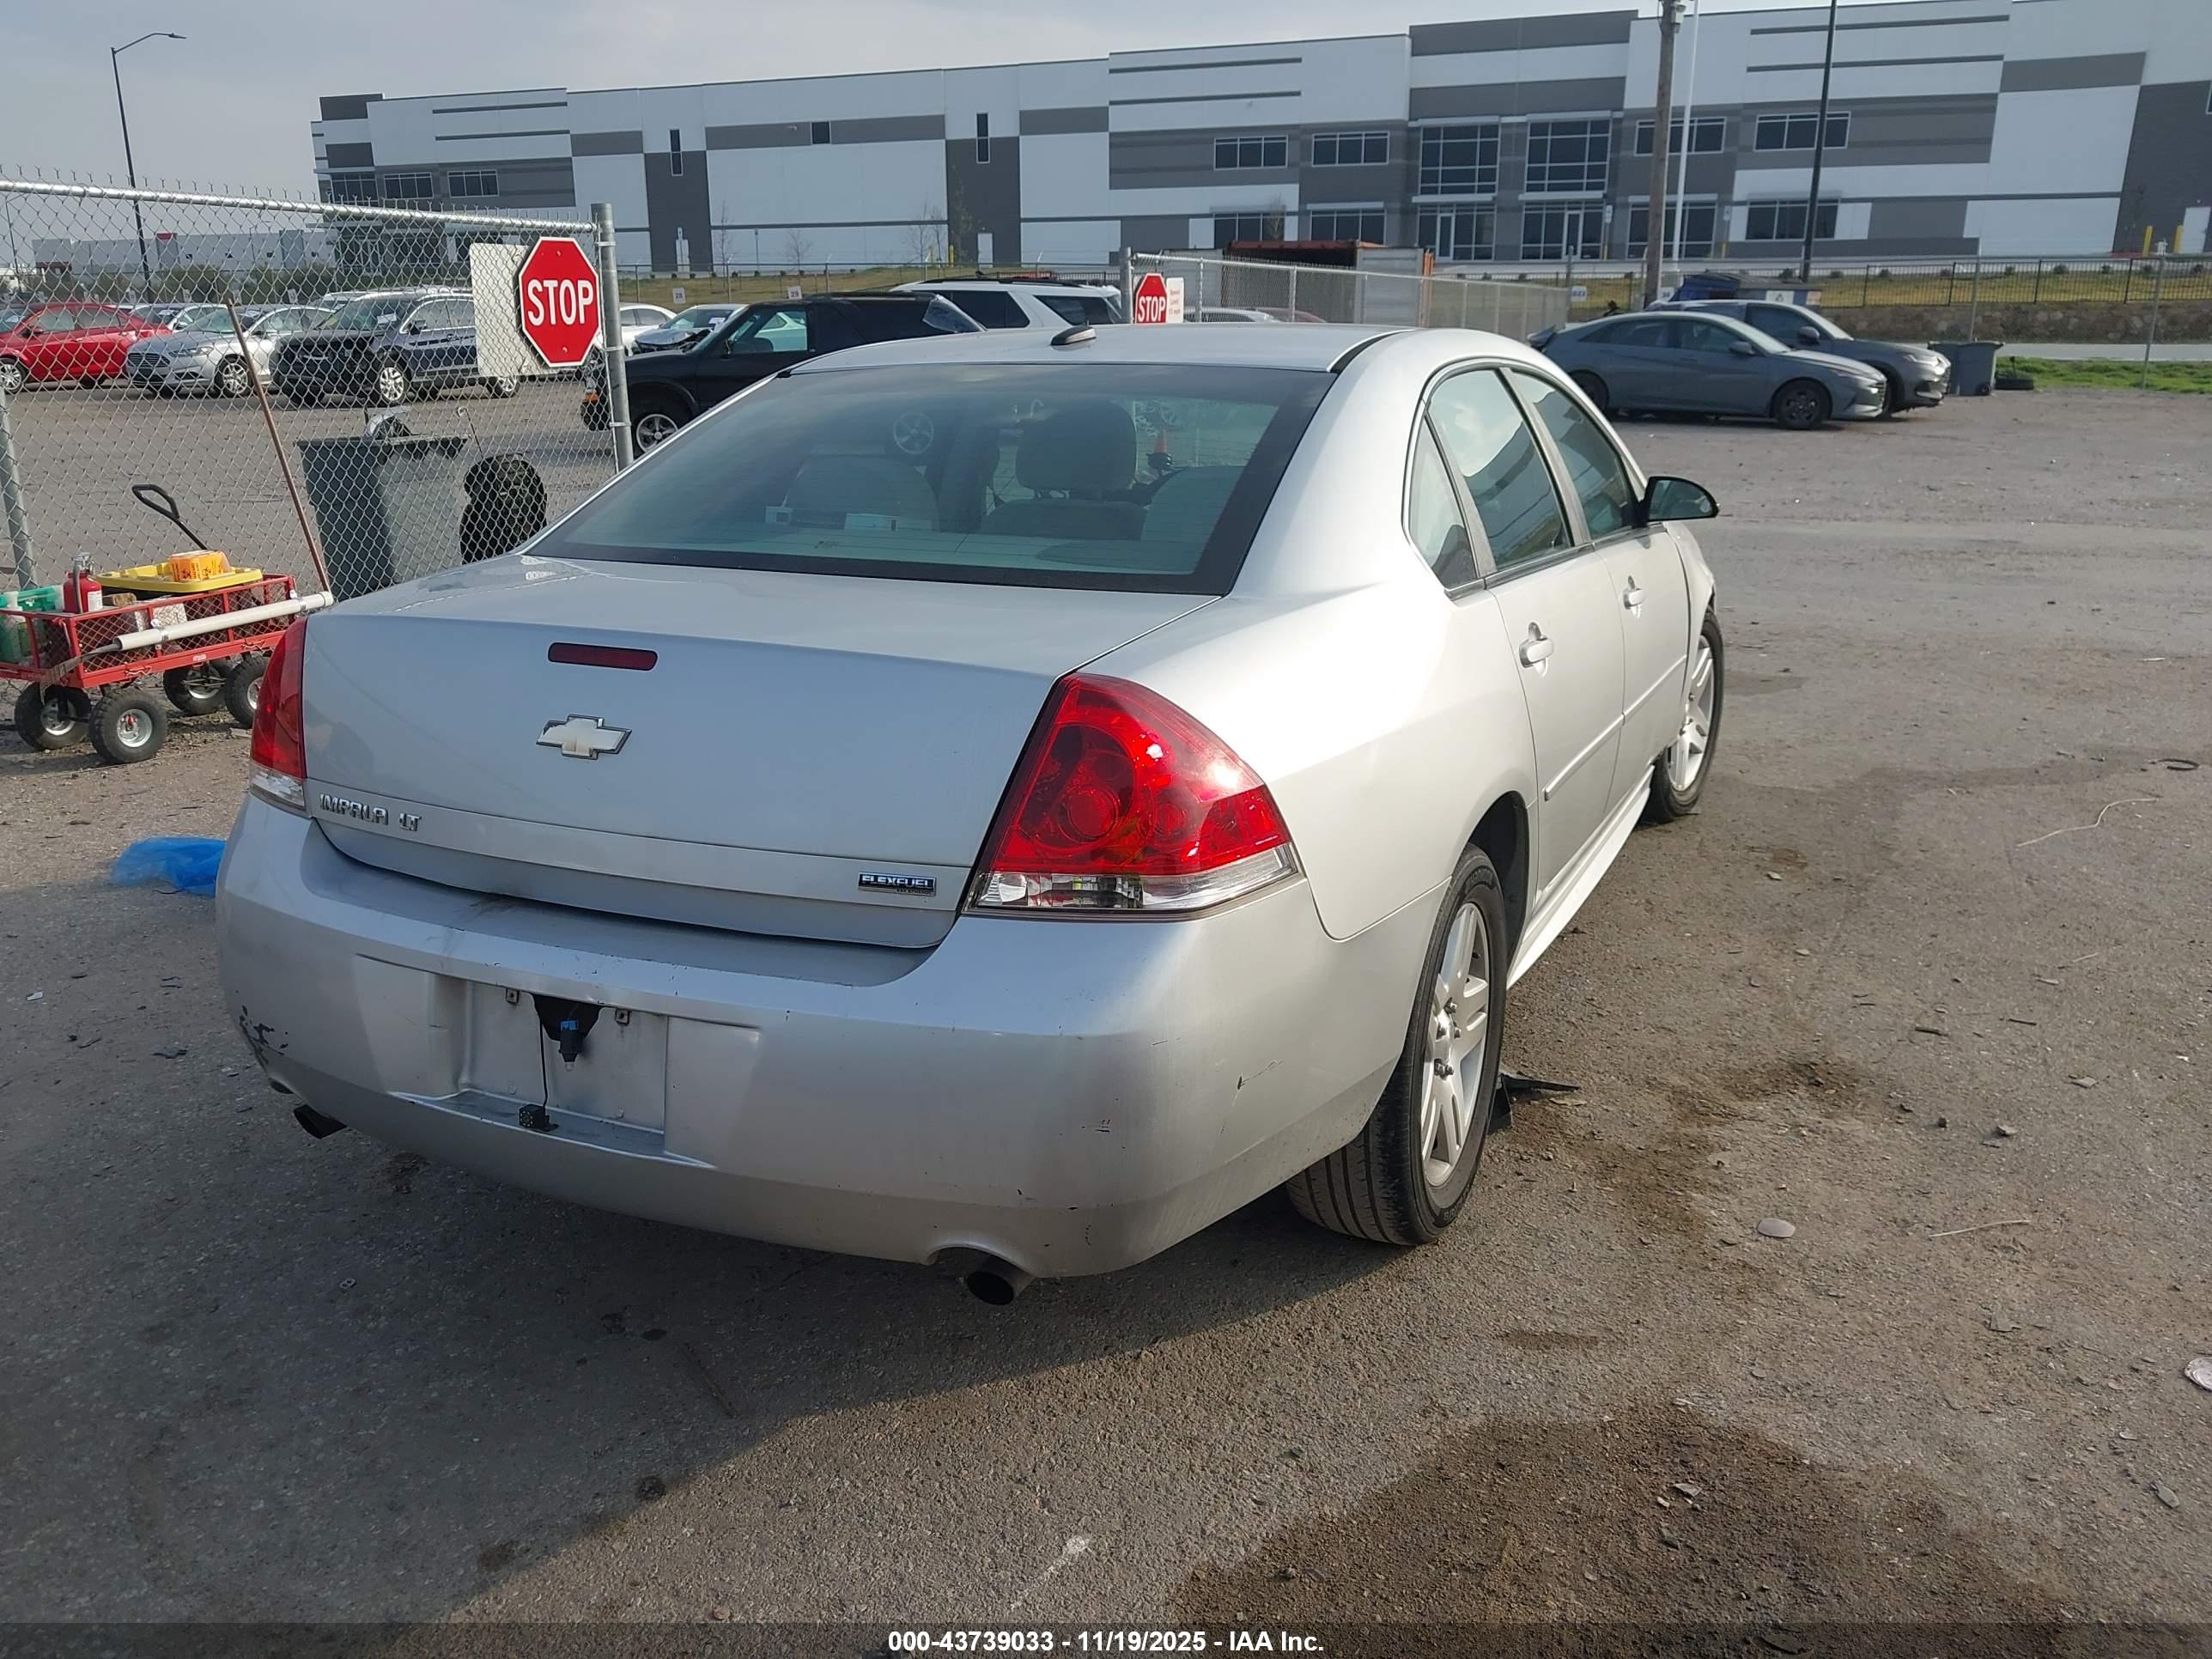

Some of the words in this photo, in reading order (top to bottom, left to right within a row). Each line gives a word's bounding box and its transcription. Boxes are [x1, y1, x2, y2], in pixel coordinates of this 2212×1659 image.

[527, 279, 593, 326] STOP
[1138, 295, 1165, 322] STOP
[319, 793, 389, 825] IMPALA
[398, 812, 422, 831] LT
